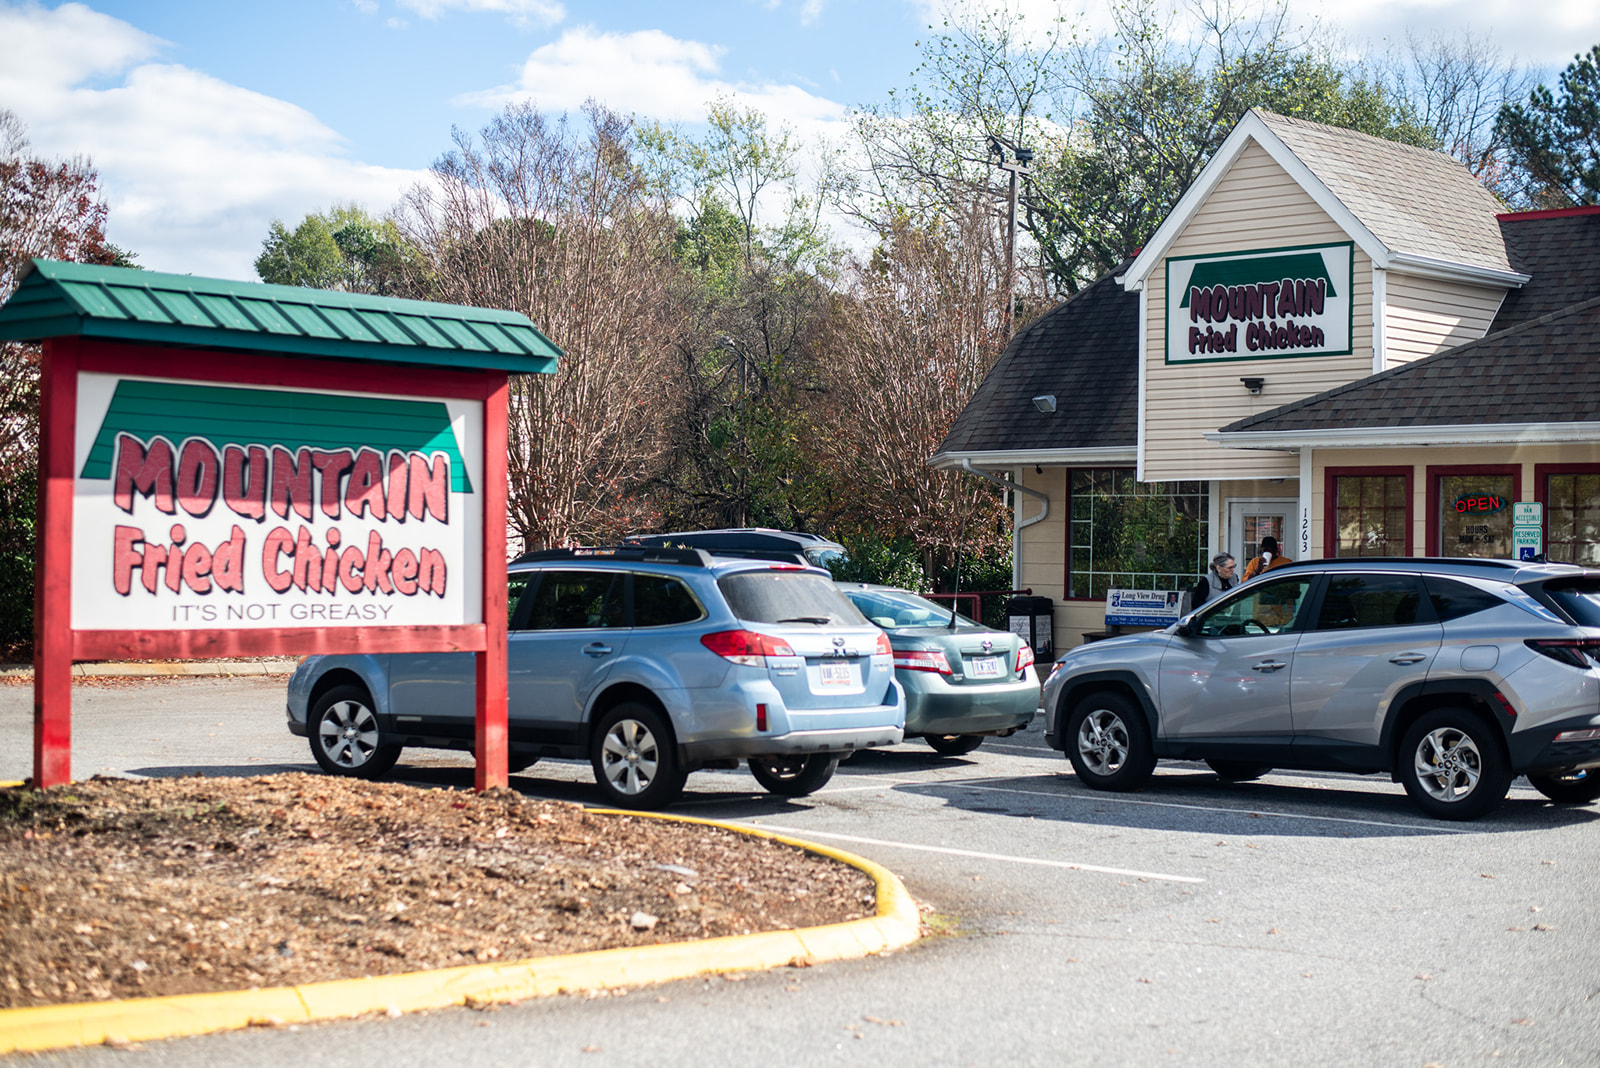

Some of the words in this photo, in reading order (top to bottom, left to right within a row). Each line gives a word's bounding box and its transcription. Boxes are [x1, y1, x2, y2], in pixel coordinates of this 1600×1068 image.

[1190, 279, 1326, 323] MOUNTAIN
[1189, 324, 1237, 354] Fried
[1246, 320, 1325, 351] Chicken
[114, 432, 449, 524] MOUNTAIN
[1455, 496, 1500, 513] OPEN
[1515, 530, 1540, 538] RESERVED
[1516, 537, 1538, 546] PARKING
[113, 523, 245, 597] Fried
[262, 525, 448, 598] Chicken
[1121, 591, 1135, 600] Long
[1151, 592, 1165, 601] Drug
[172, 604, 217, 621] IT'S
[227, 603, 281, 620] NOT
[290, 603, 393, 620] GREASY
